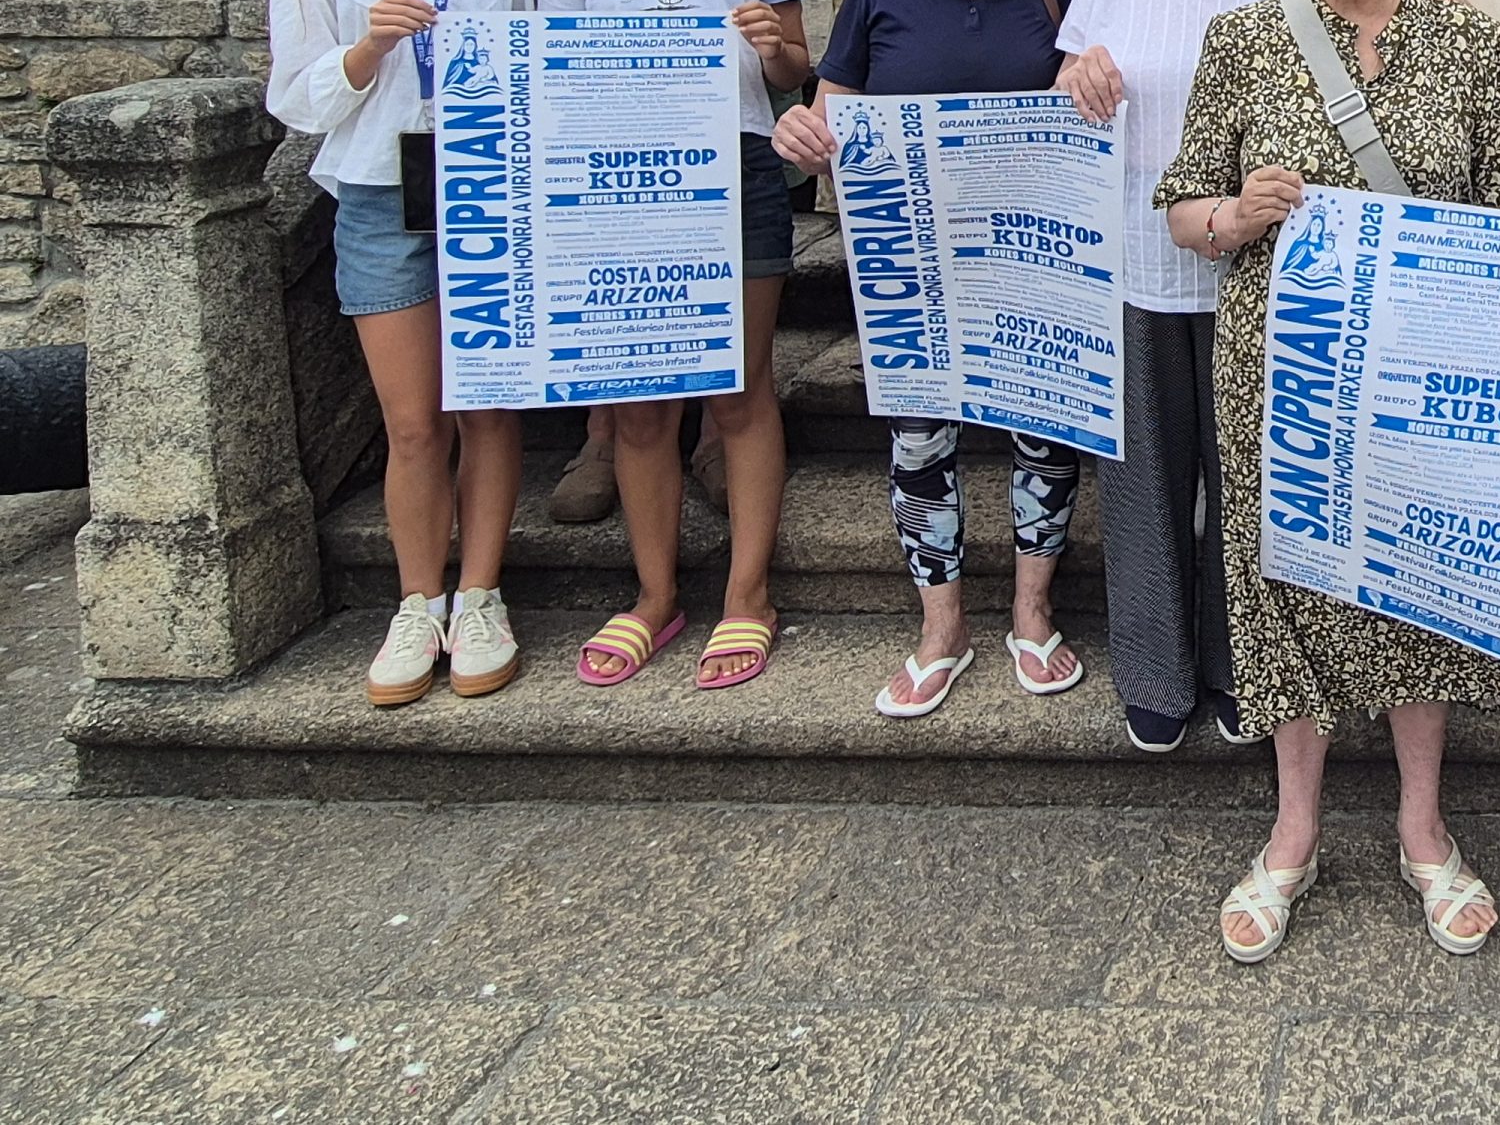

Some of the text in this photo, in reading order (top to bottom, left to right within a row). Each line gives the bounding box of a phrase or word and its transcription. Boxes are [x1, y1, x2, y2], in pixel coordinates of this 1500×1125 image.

[589, 149, 716, 168] SUPERTOP
[588, 169, 681, 189] KUBO
[444, 105, 511, 349] SAN CIPRIAN
[990, 213, 1103, 245] SUPERTOP
[992, 229, 1073, 257] KUBO
[589, 261, 732, 285] COSTA DORADA
[843, 178, 930, 369] SAN CIPRIAN
[583, 284, 687, 306] ARIZONA
[991, 331, 1078, 362] ARIZONA
[995, 313, 1114, 356] COSTA DORADA
[1332, 202, 1383, 549] FESTAS EN HONRA A VIRXE DO CARMEN 2026
[1269, 292, 1345, 541] SAN CIPRIAN
[1405, 503, 1470, 535] COSTA
